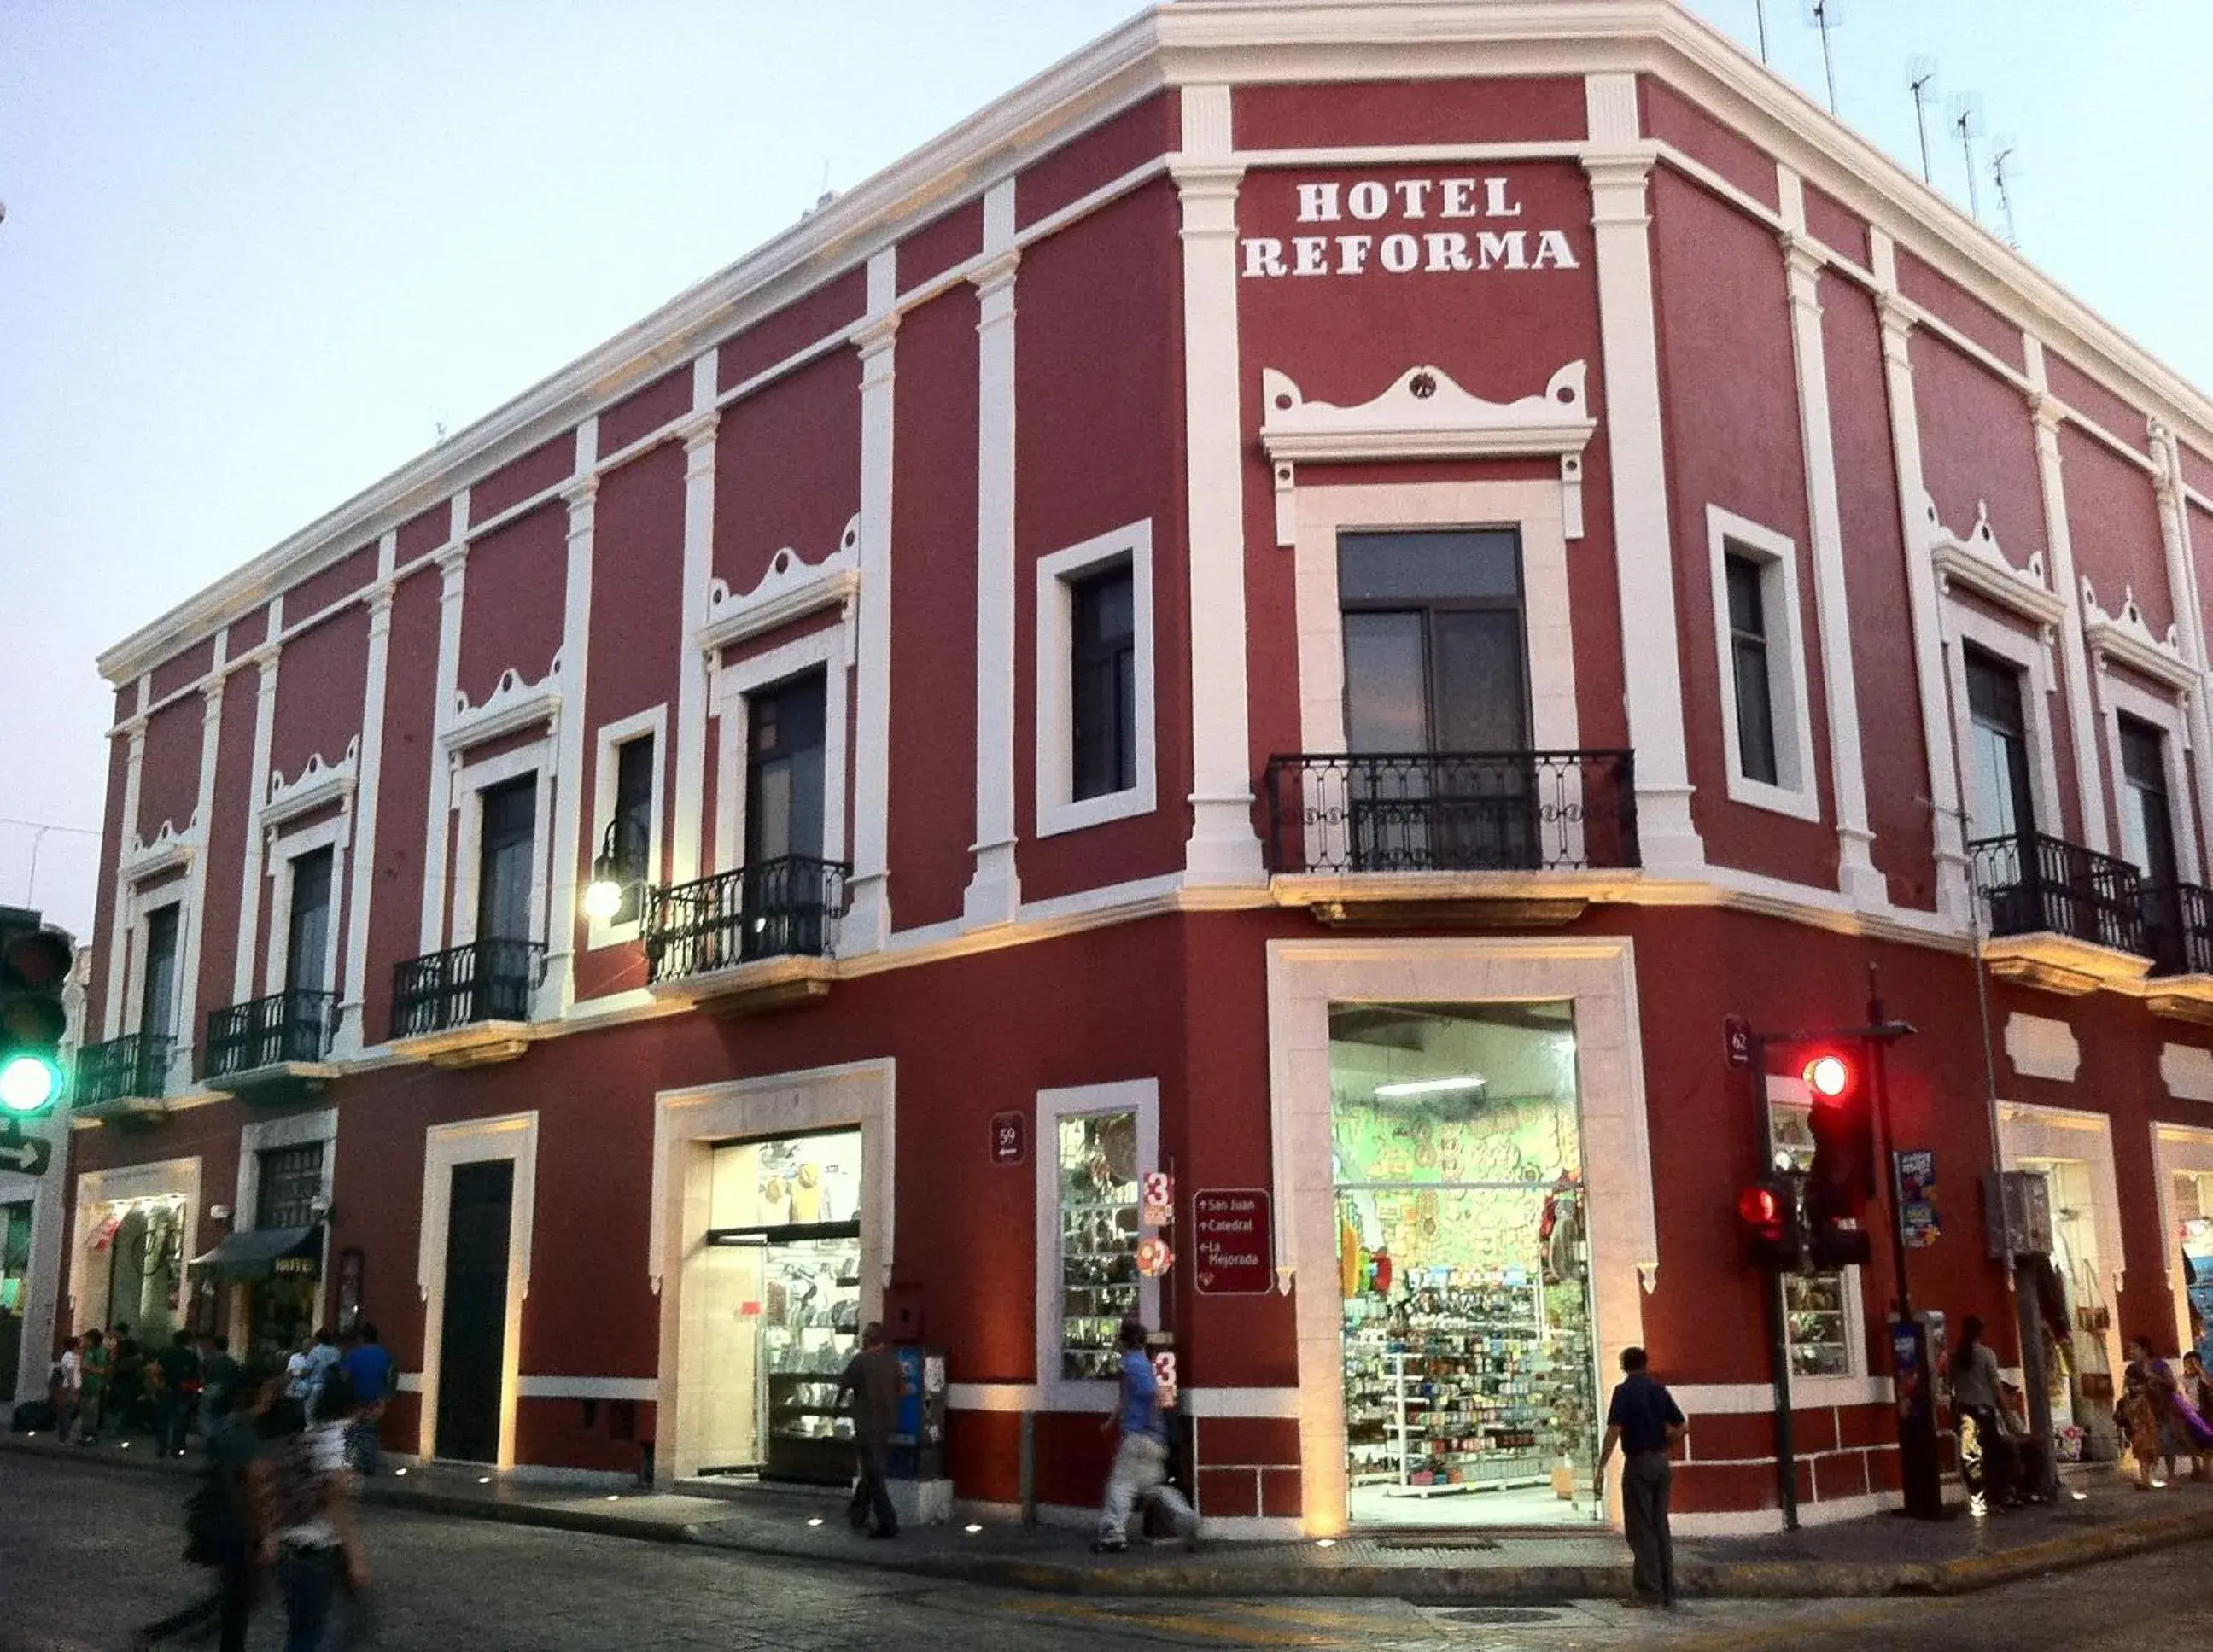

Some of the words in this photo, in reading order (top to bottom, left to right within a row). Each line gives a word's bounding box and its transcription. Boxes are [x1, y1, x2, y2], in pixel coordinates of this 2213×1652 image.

[1296, 178, 1522, 222] HOTEL
[1241, 230, 1580, 277] REFORMA
[1732, 1033, 1748, 1049] 62
[1000, 1127, 1016, 1144] 59
[1208, 1199, 1228, 1211] San
[1230, 1198, 1255, 1211] Juan
[1208, 1218, 1252, 1232] Catedral
[1209, 1240, 1221, 1252] La
[1209, 1253, 1259, 1268] Mejorada
